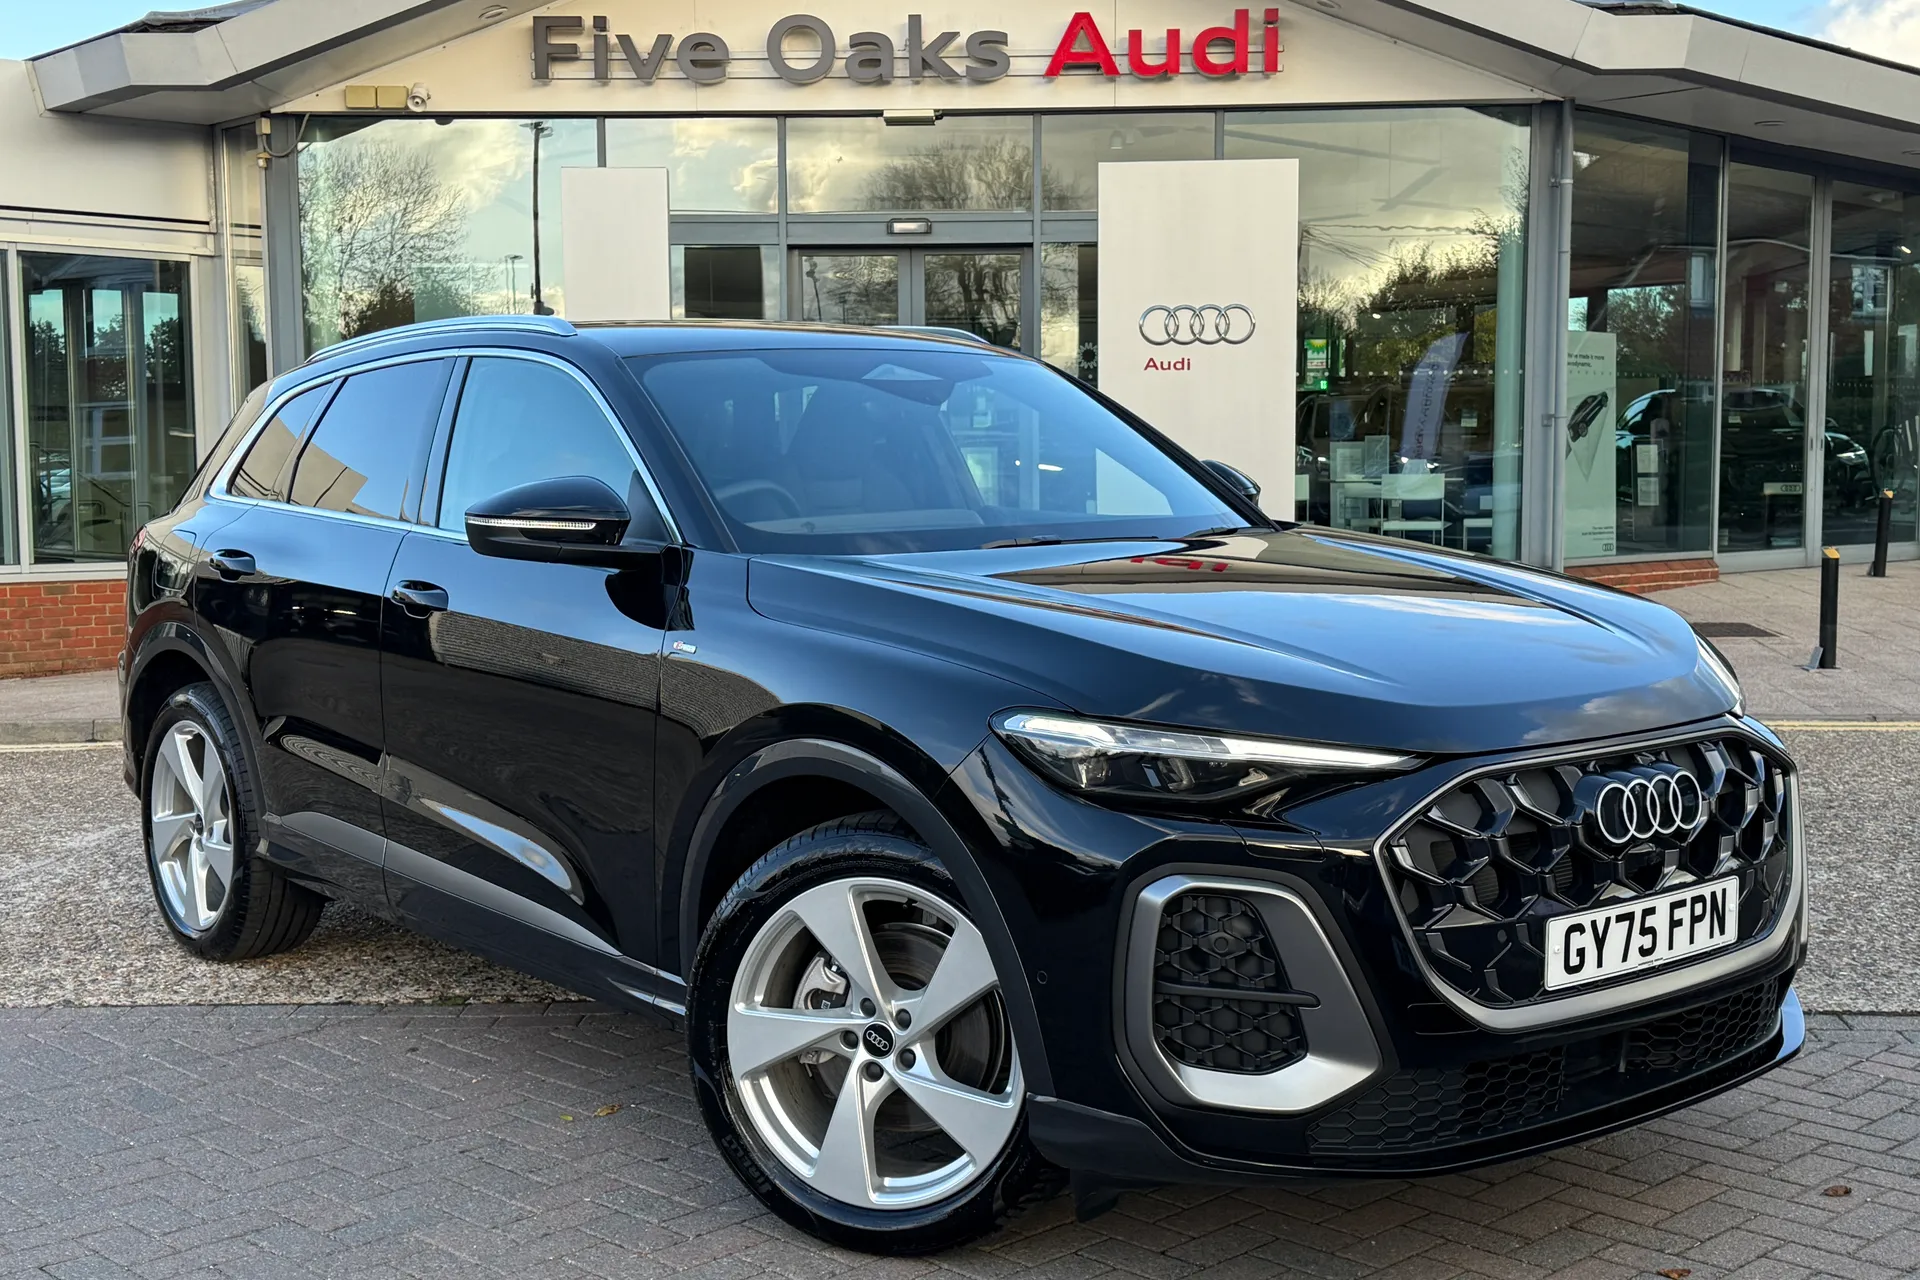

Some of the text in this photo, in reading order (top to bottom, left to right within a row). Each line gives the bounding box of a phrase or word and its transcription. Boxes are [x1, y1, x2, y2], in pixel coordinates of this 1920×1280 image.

[533, 8, 1279, 84] Five Oaks Audi
[1143, 357, 1191, 371] Audi
[1563, 887, 1727, 976] GY75 FPN
